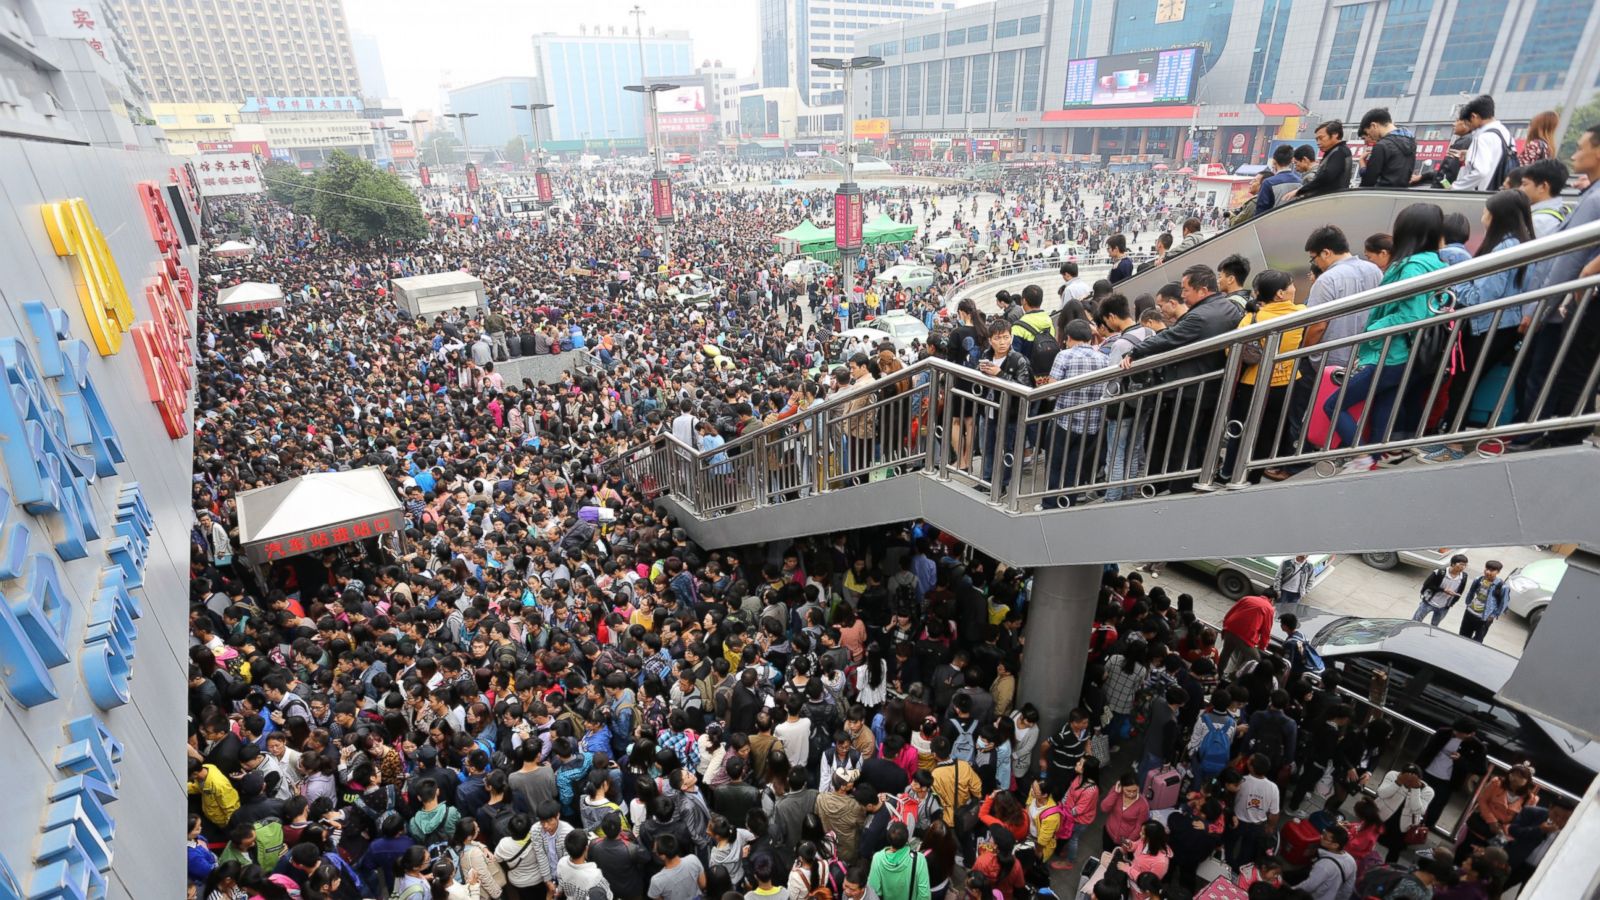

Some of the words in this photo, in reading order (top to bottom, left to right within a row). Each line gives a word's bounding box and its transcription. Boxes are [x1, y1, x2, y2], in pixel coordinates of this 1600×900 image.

[263, 516, 391, 560] 汽车站进站口
[24, 713, 124, 900] HINA
